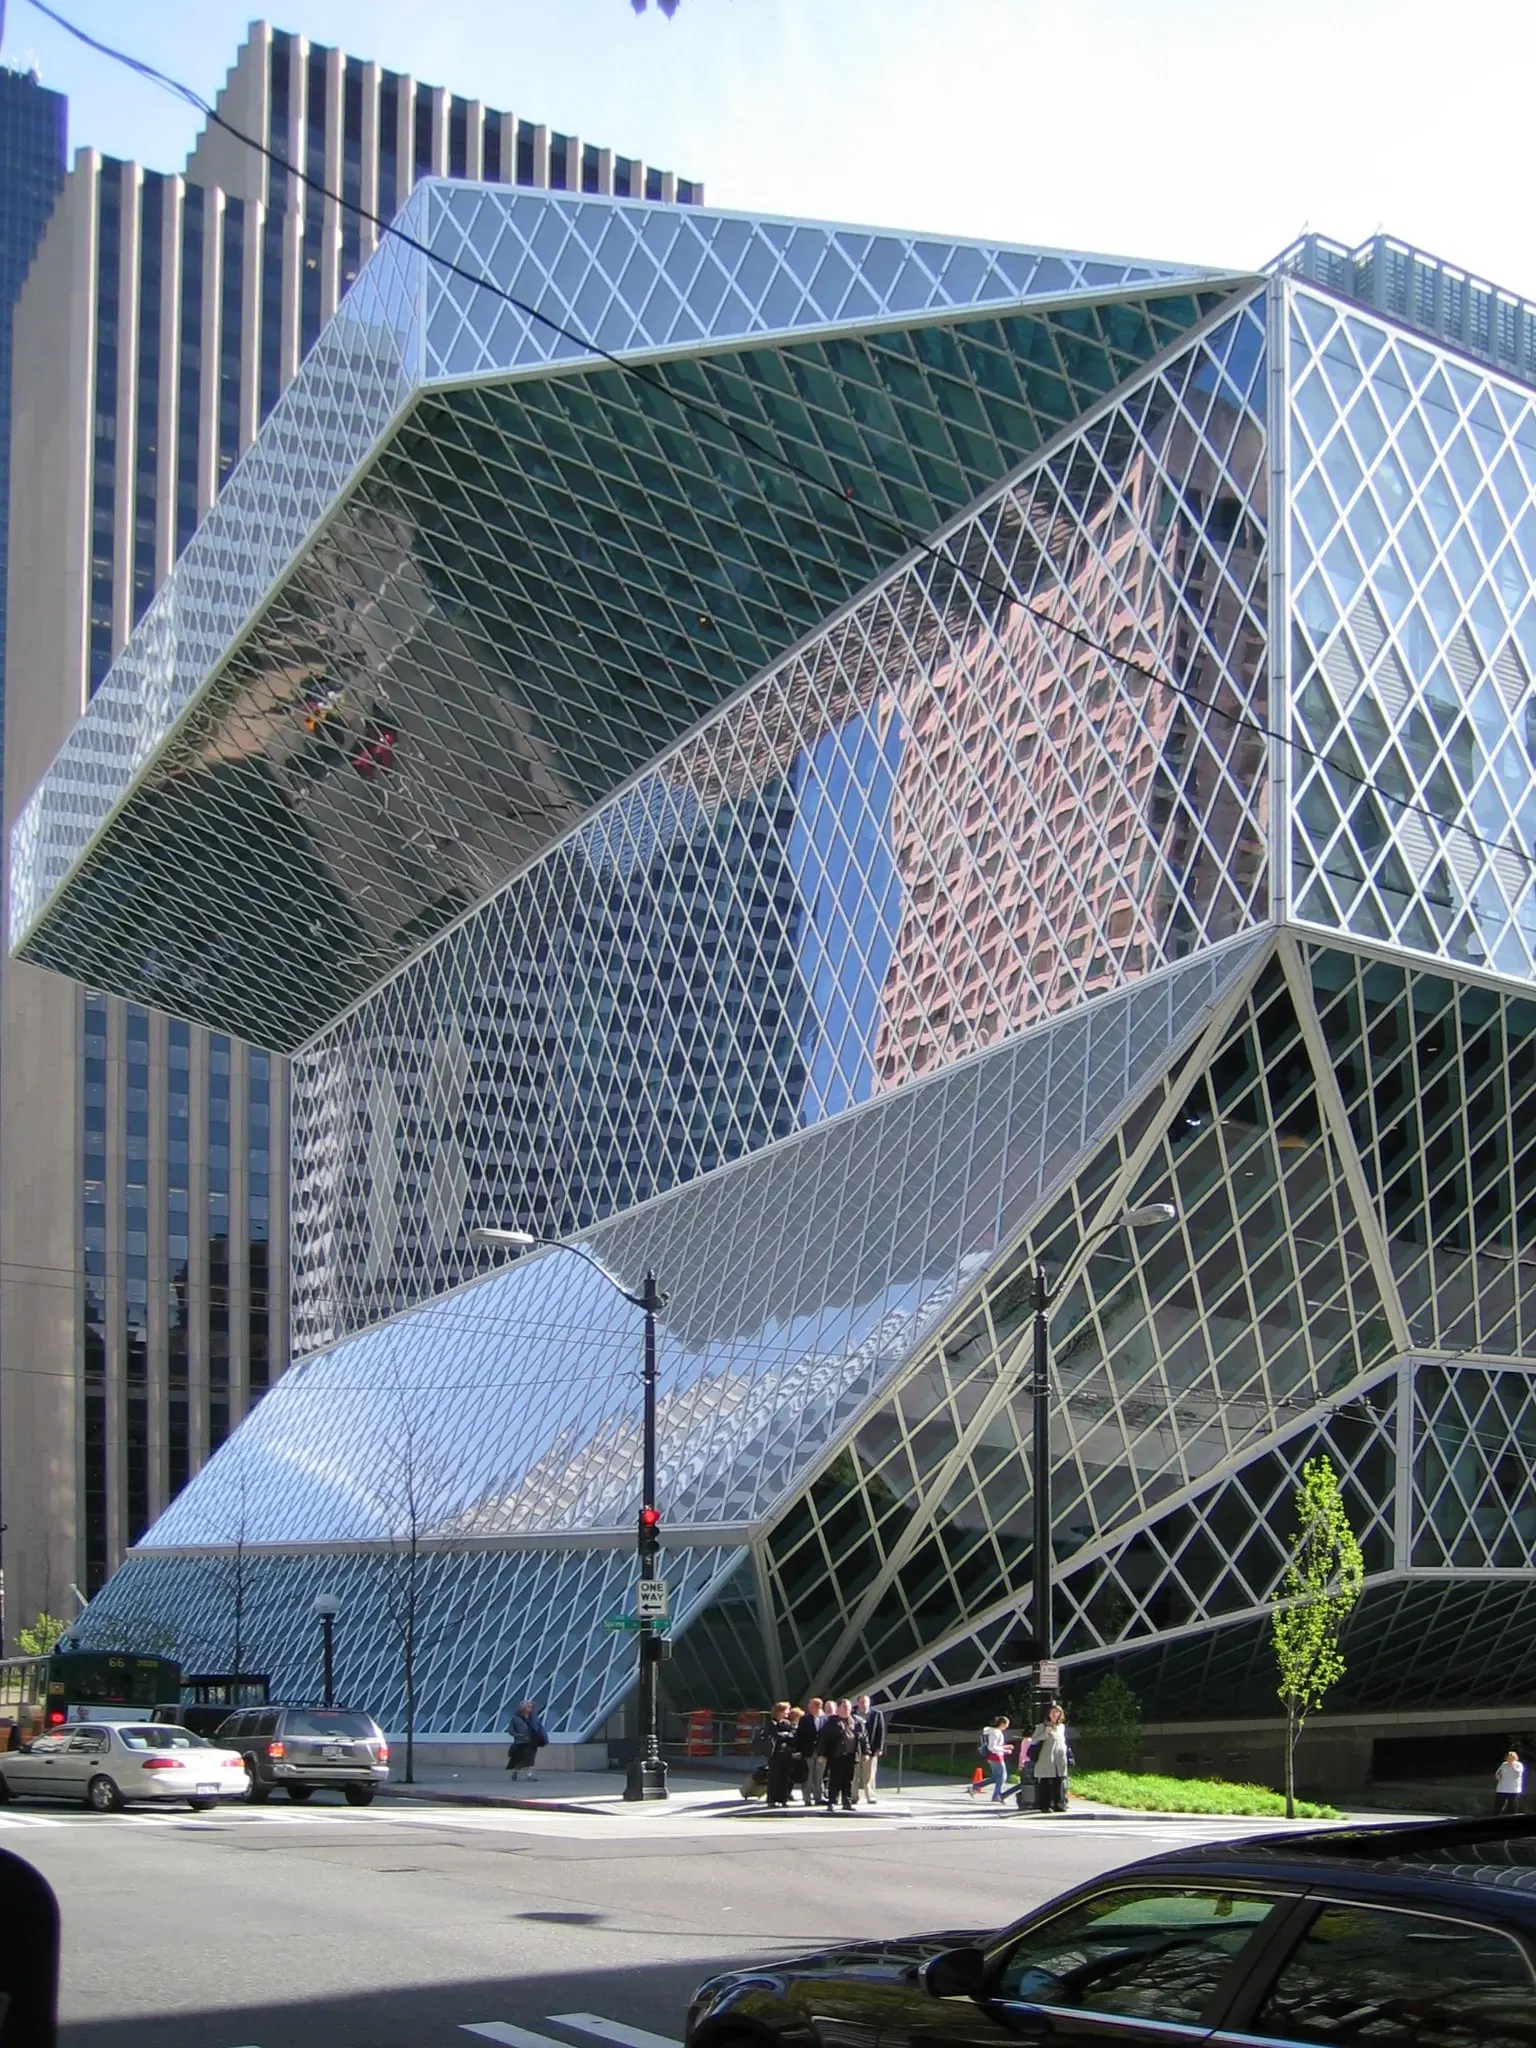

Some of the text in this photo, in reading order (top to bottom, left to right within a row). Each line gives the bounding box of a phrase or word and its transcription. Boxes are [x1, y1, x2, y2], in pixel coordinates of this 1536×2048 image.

[641, 1583, 664, 1592] ONE
[641, 1593, 664, 1601] WAY
[109, 1657, 125, 1667] 66
